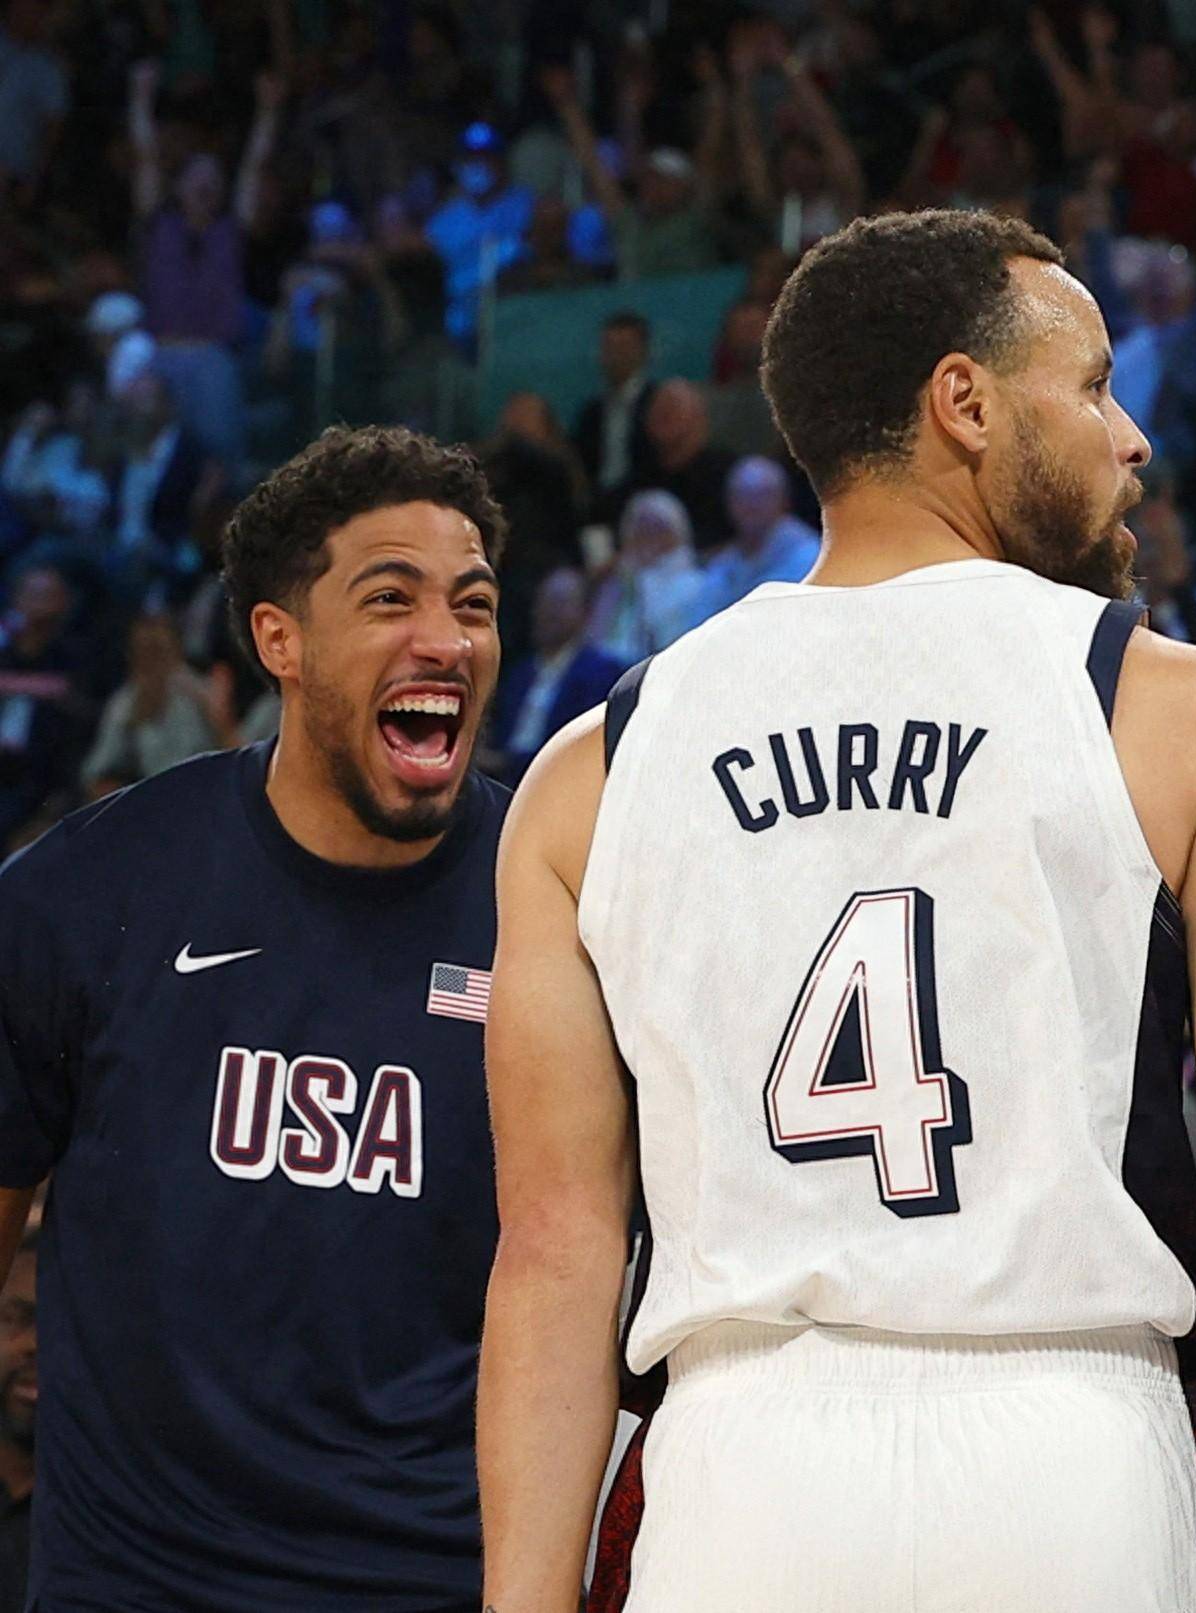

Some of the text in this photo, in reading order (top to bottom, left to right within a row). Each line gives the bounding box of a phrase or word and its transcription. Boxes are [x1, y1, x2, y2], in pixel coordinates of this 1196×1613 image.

[712, 719, 989, 833] CURRY
[210, 1046, 423, 1198] USA
[762, 887, 973, 1219] 4
